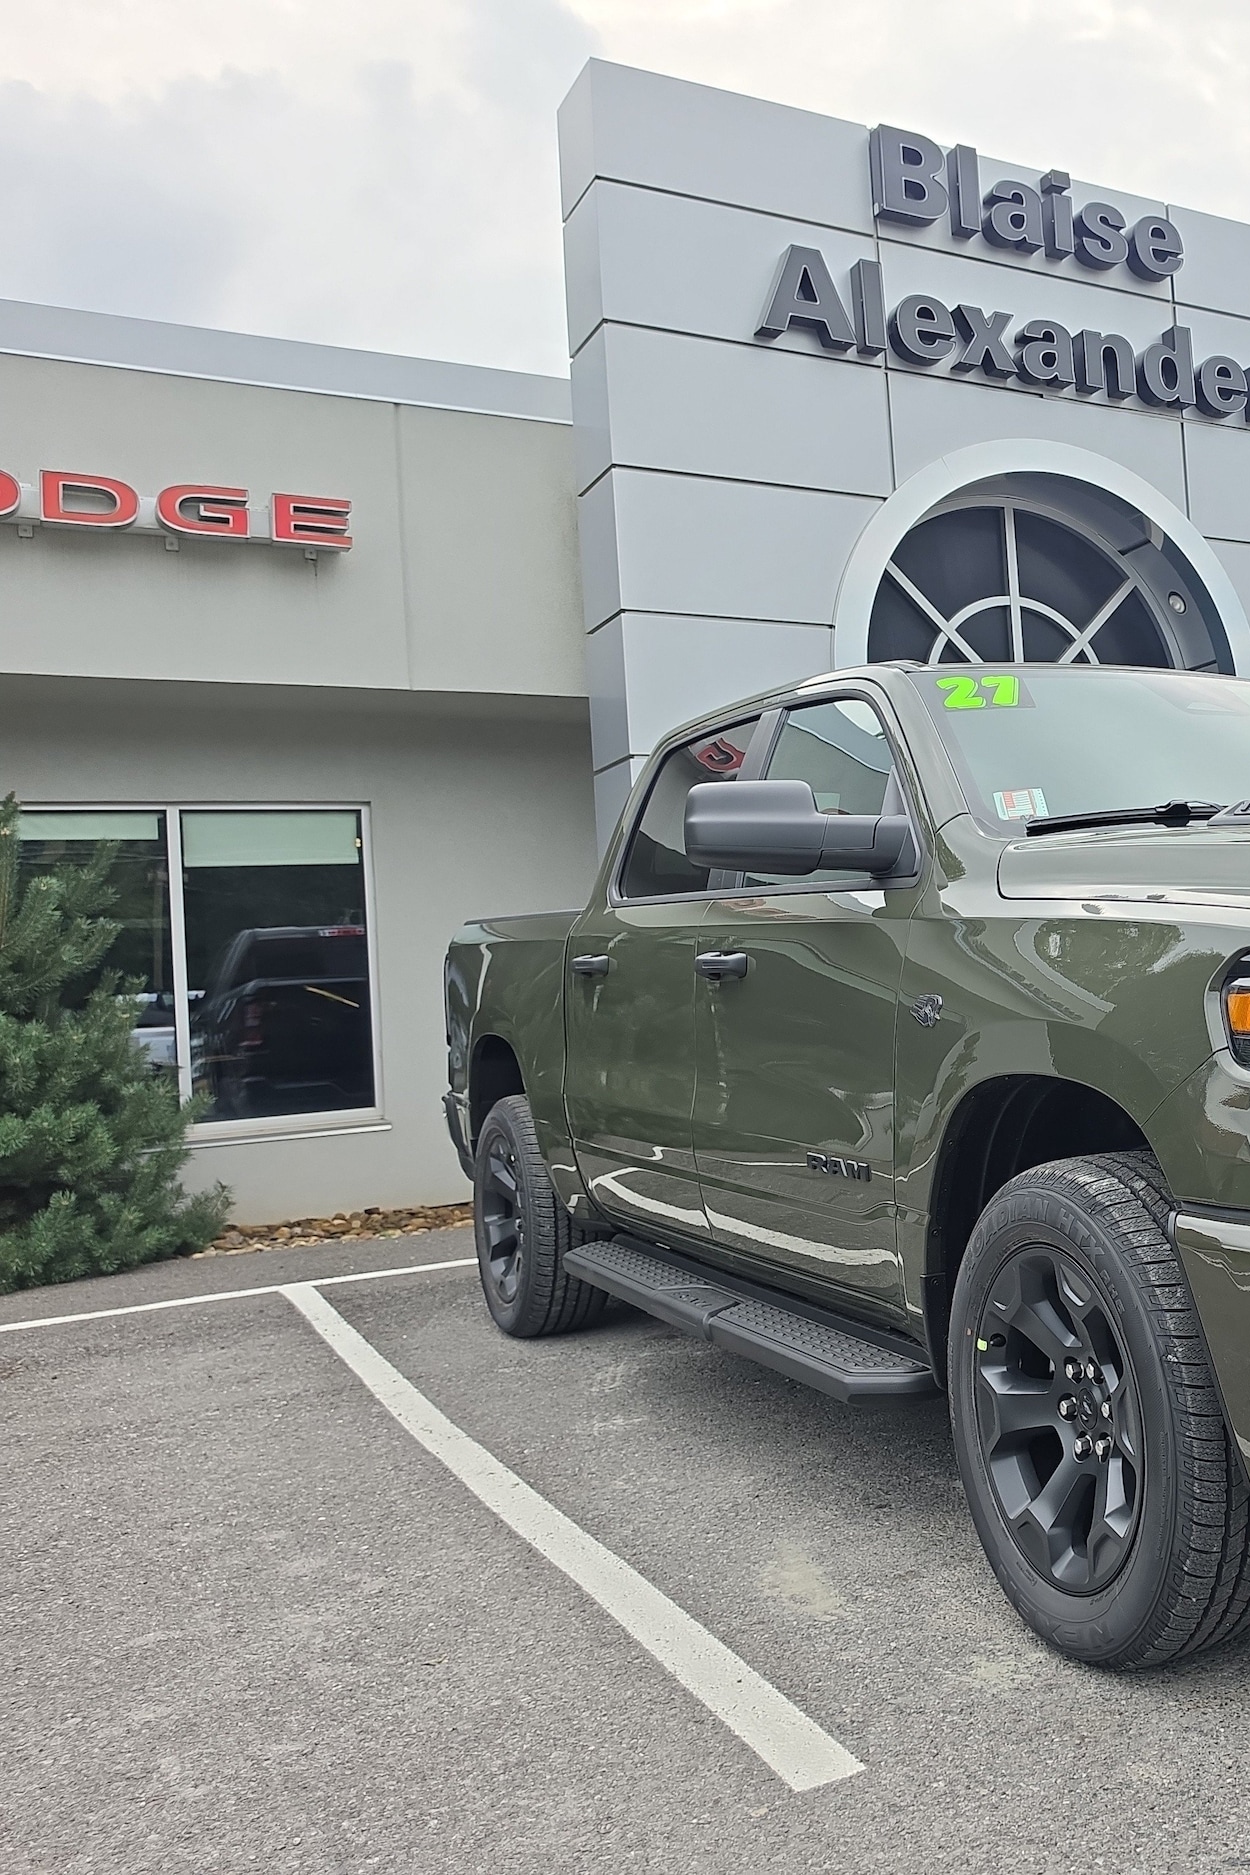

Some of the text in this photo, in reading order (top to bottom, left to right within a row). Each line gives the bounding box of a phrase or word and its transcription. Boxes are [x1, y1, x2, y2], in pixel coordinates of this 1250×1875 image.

[870, 123, 1184, 283] Blaise
[0, 470, 352, 551] DGE
[936, 675, 1020, 709] 27
[807, 1151, 872, 1182] RAM
[1058, 1207, 1105, 1269] HTX
